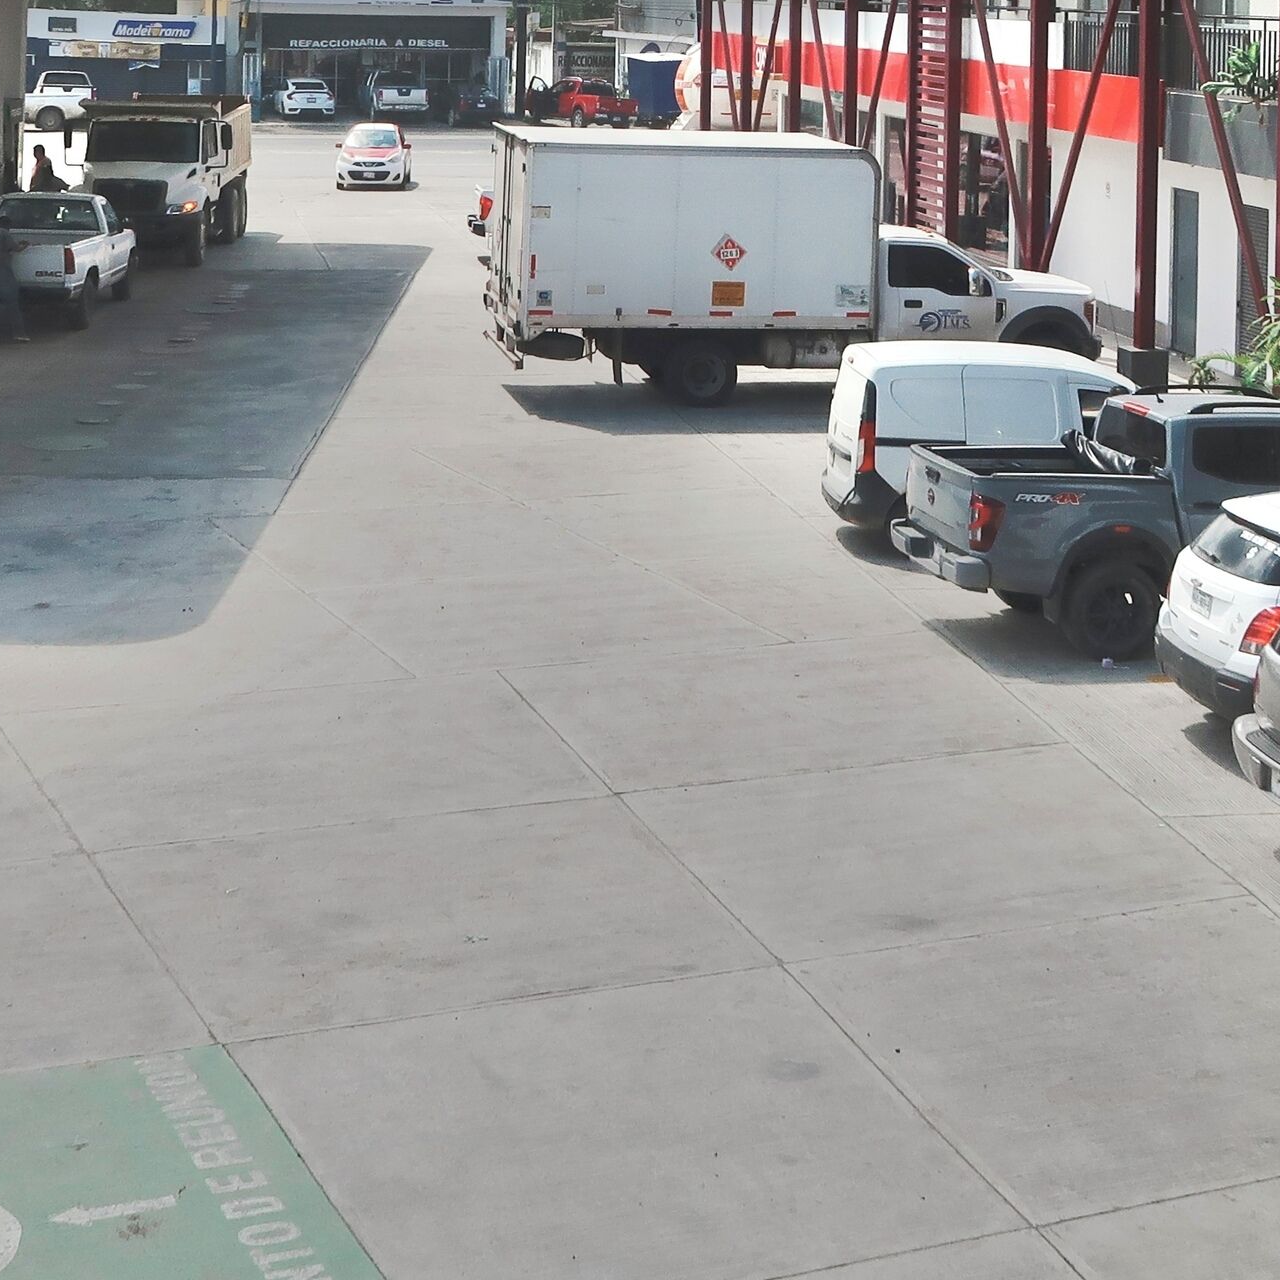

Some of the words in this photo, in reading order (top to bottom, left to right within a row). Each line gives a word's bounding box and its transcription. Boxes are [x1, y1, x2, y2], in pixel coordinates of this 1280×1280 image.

[289, 38, 387, 48] REFACCIONARIA
[395, 39, 403, 47] A
[408, 39, 449, 48] DIESEL
